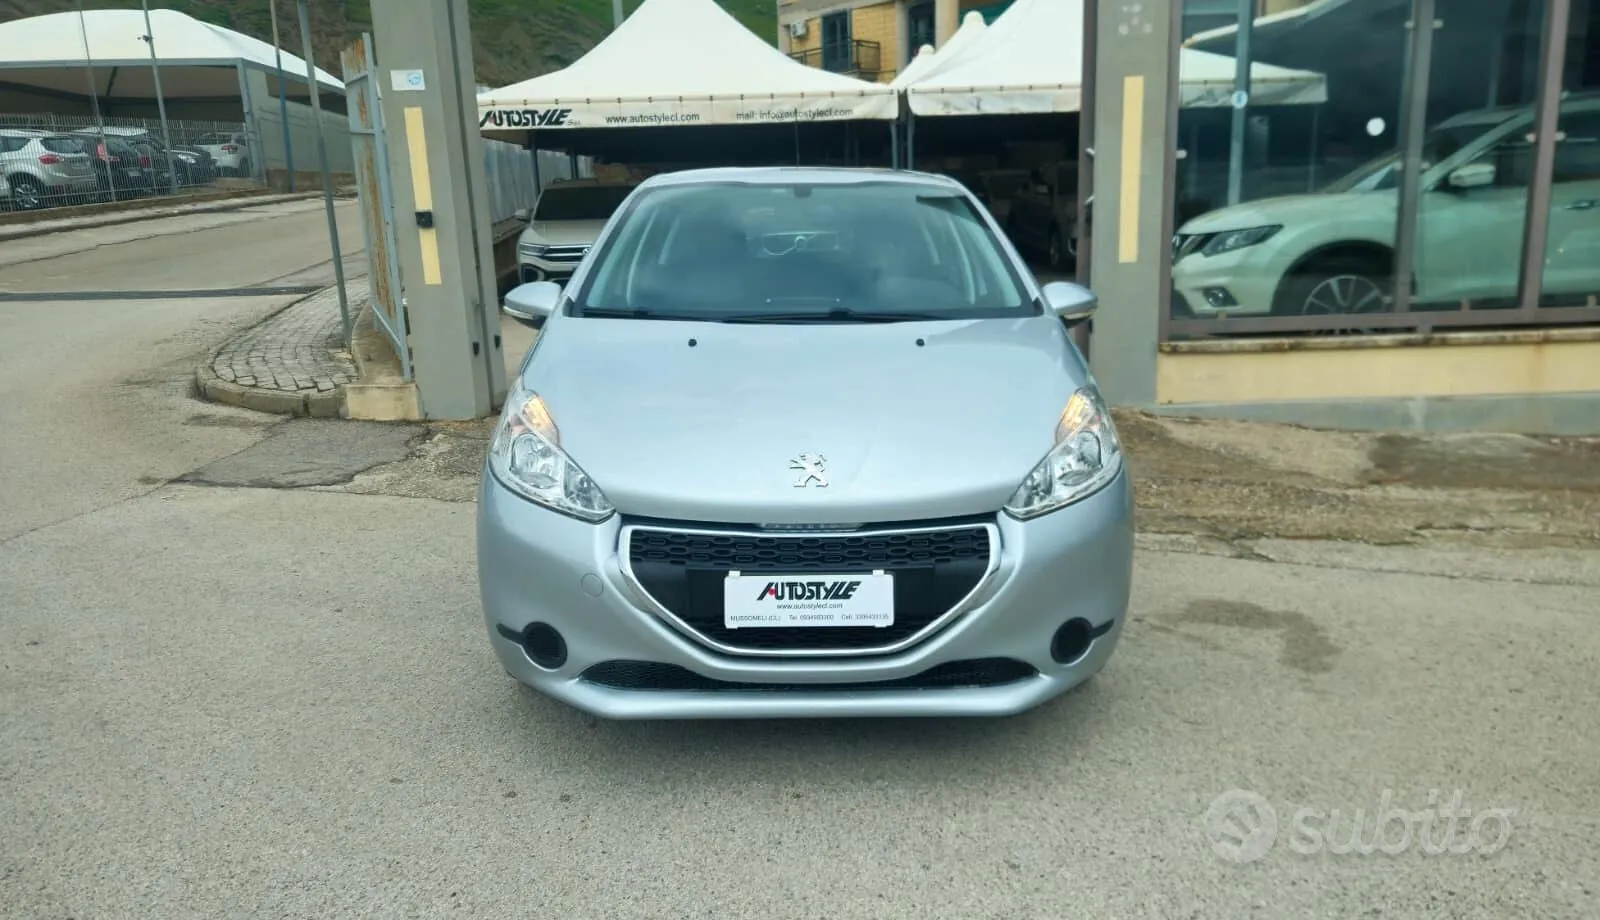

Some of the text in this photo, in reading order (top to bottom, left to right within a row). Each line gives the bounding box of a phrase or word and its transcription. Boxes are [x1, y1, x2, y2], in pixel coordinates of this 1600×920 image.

[480, 108, 573, 127] AUTOSTYLE
[605, 111, 701, 124] www.autostylecl.com
[757, 580, 862, 601] AUTOSTYLE
